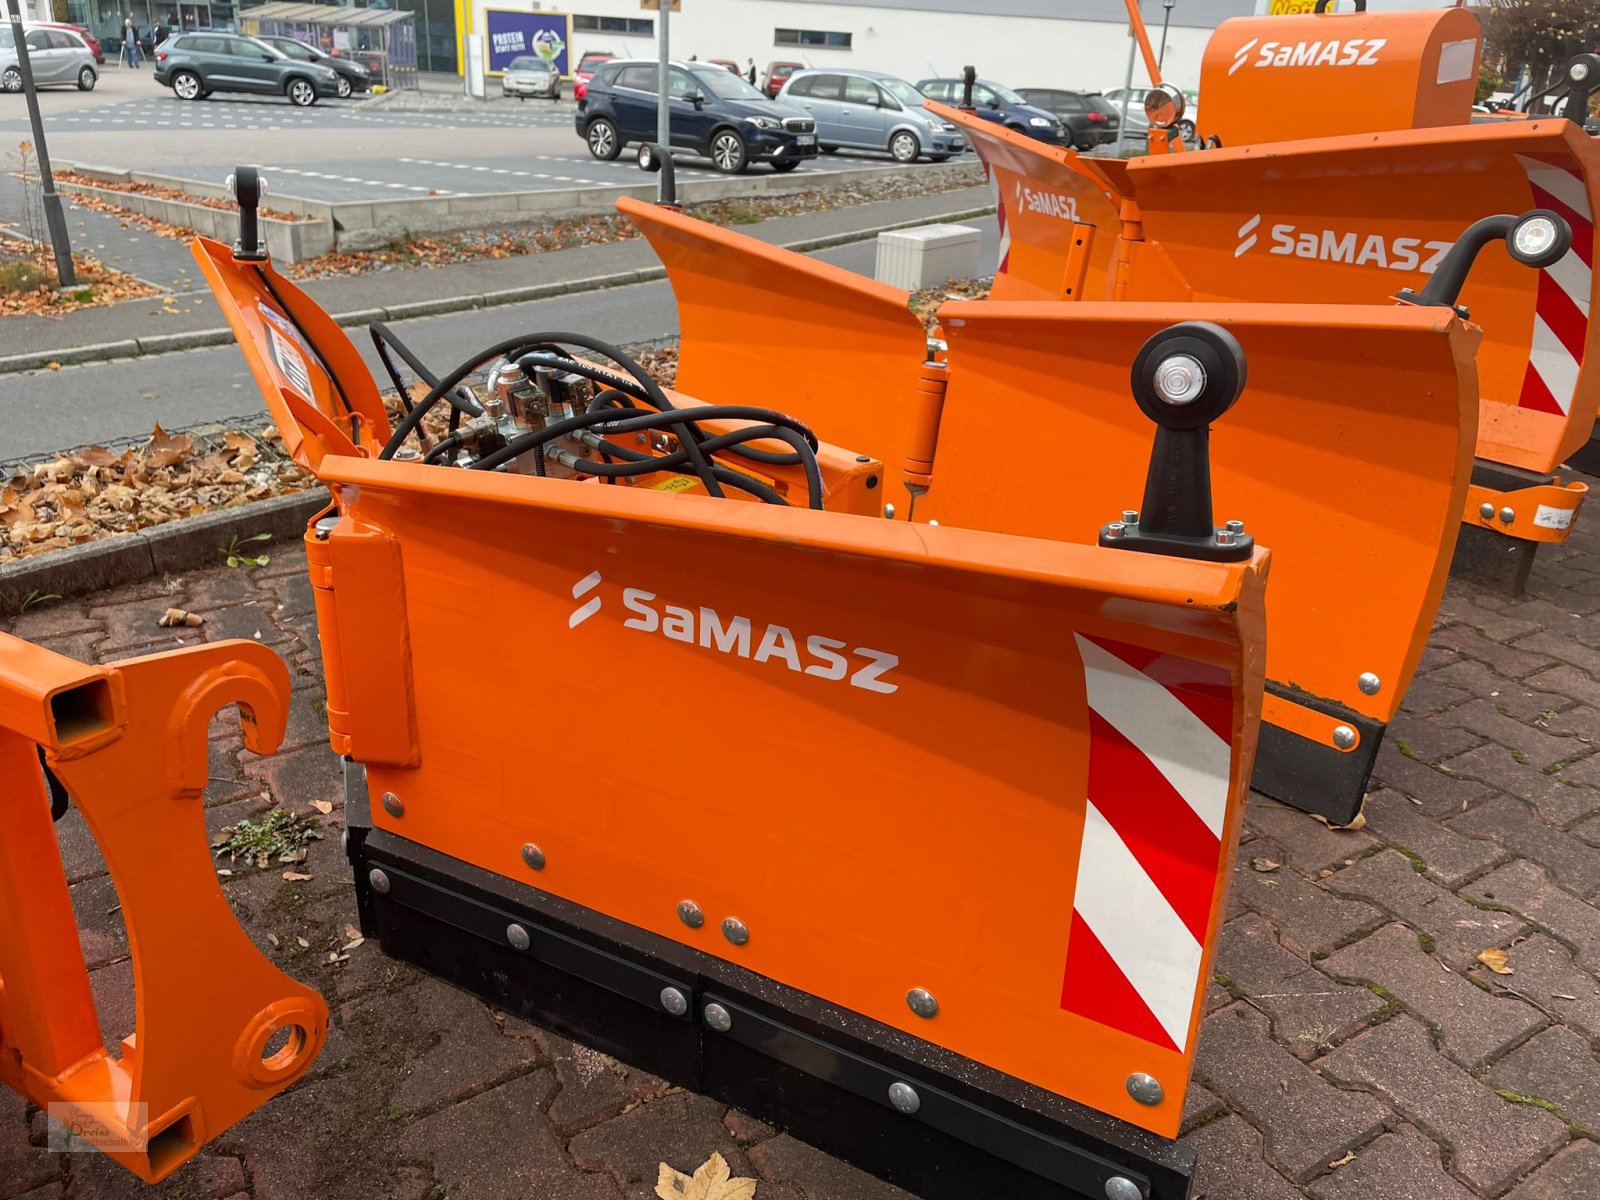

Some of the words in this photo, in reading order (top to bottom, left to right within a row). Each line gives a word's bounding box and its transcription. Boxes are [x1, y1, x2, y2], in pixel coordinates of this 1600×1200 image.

[493, 31, 524, 45] PROTEIN
[1255, 38, 1388, 68] SaMASZ
[1023, 187, 1080, 222] SaMASZ
[1270, 223, 1456, 274] SaMASZ
[623, 588, 899, 694] SaMASZ
